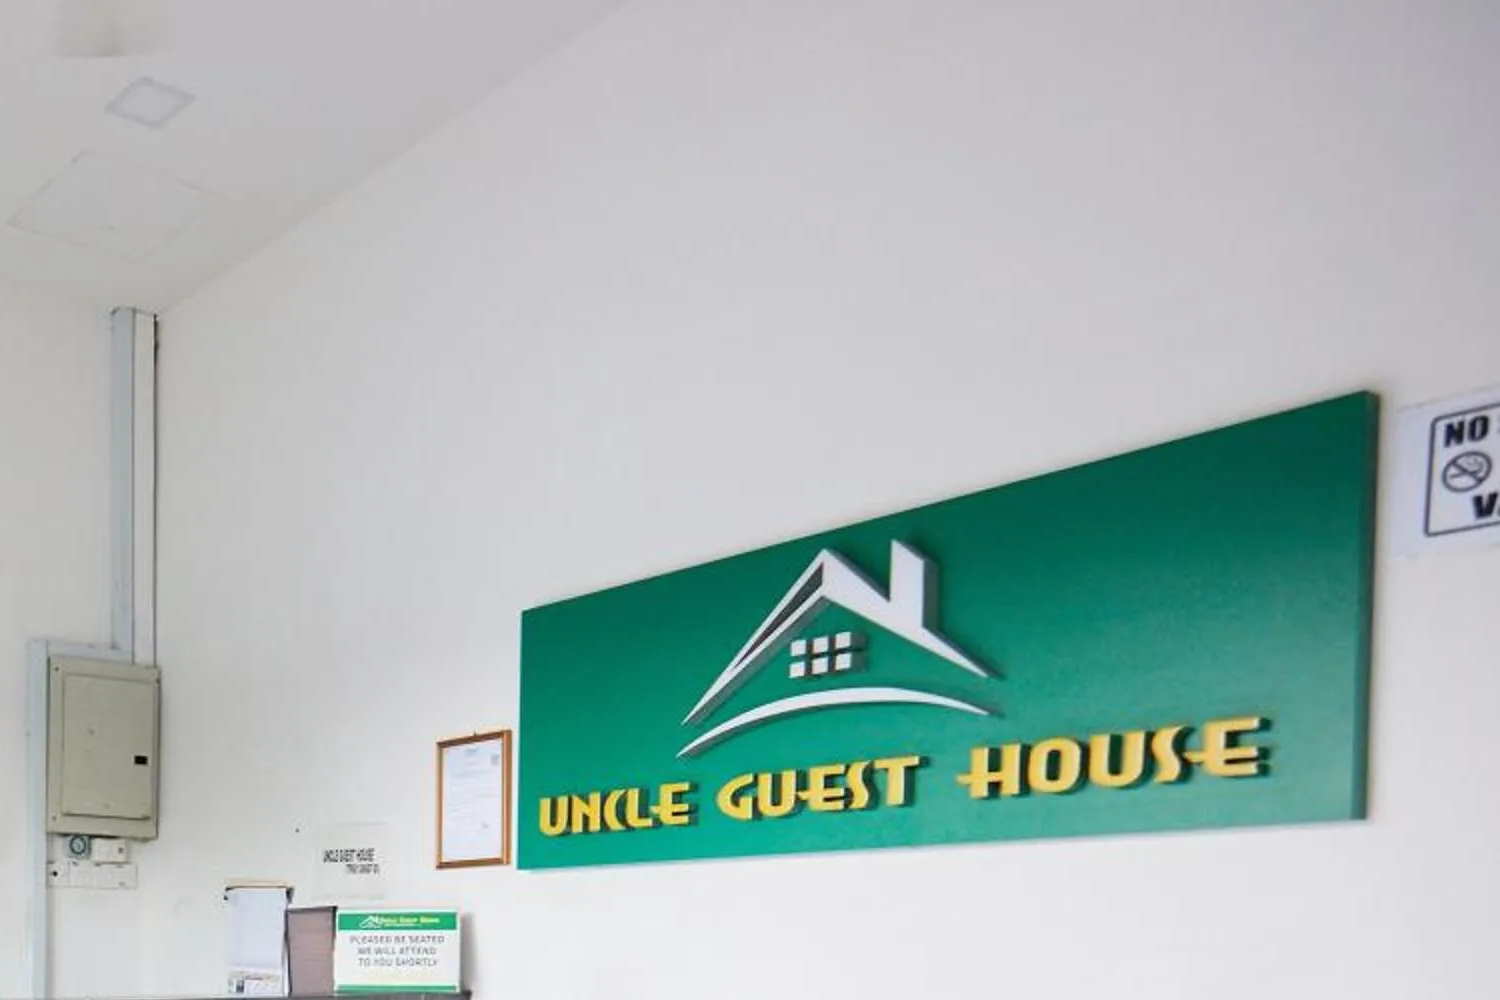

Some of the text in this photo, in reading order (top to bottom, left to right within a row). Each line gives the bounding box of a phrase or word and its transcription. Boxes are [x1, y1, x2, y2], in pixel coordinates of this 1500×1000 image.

[1444, 415, 1489, 448] NO
[1473, 492, 1500, 519] V
[539, 781, 690, 837] UNCLE
[716, 755, 920, 821] GUEST
[956, 716, 1261, 799] HOUSE
